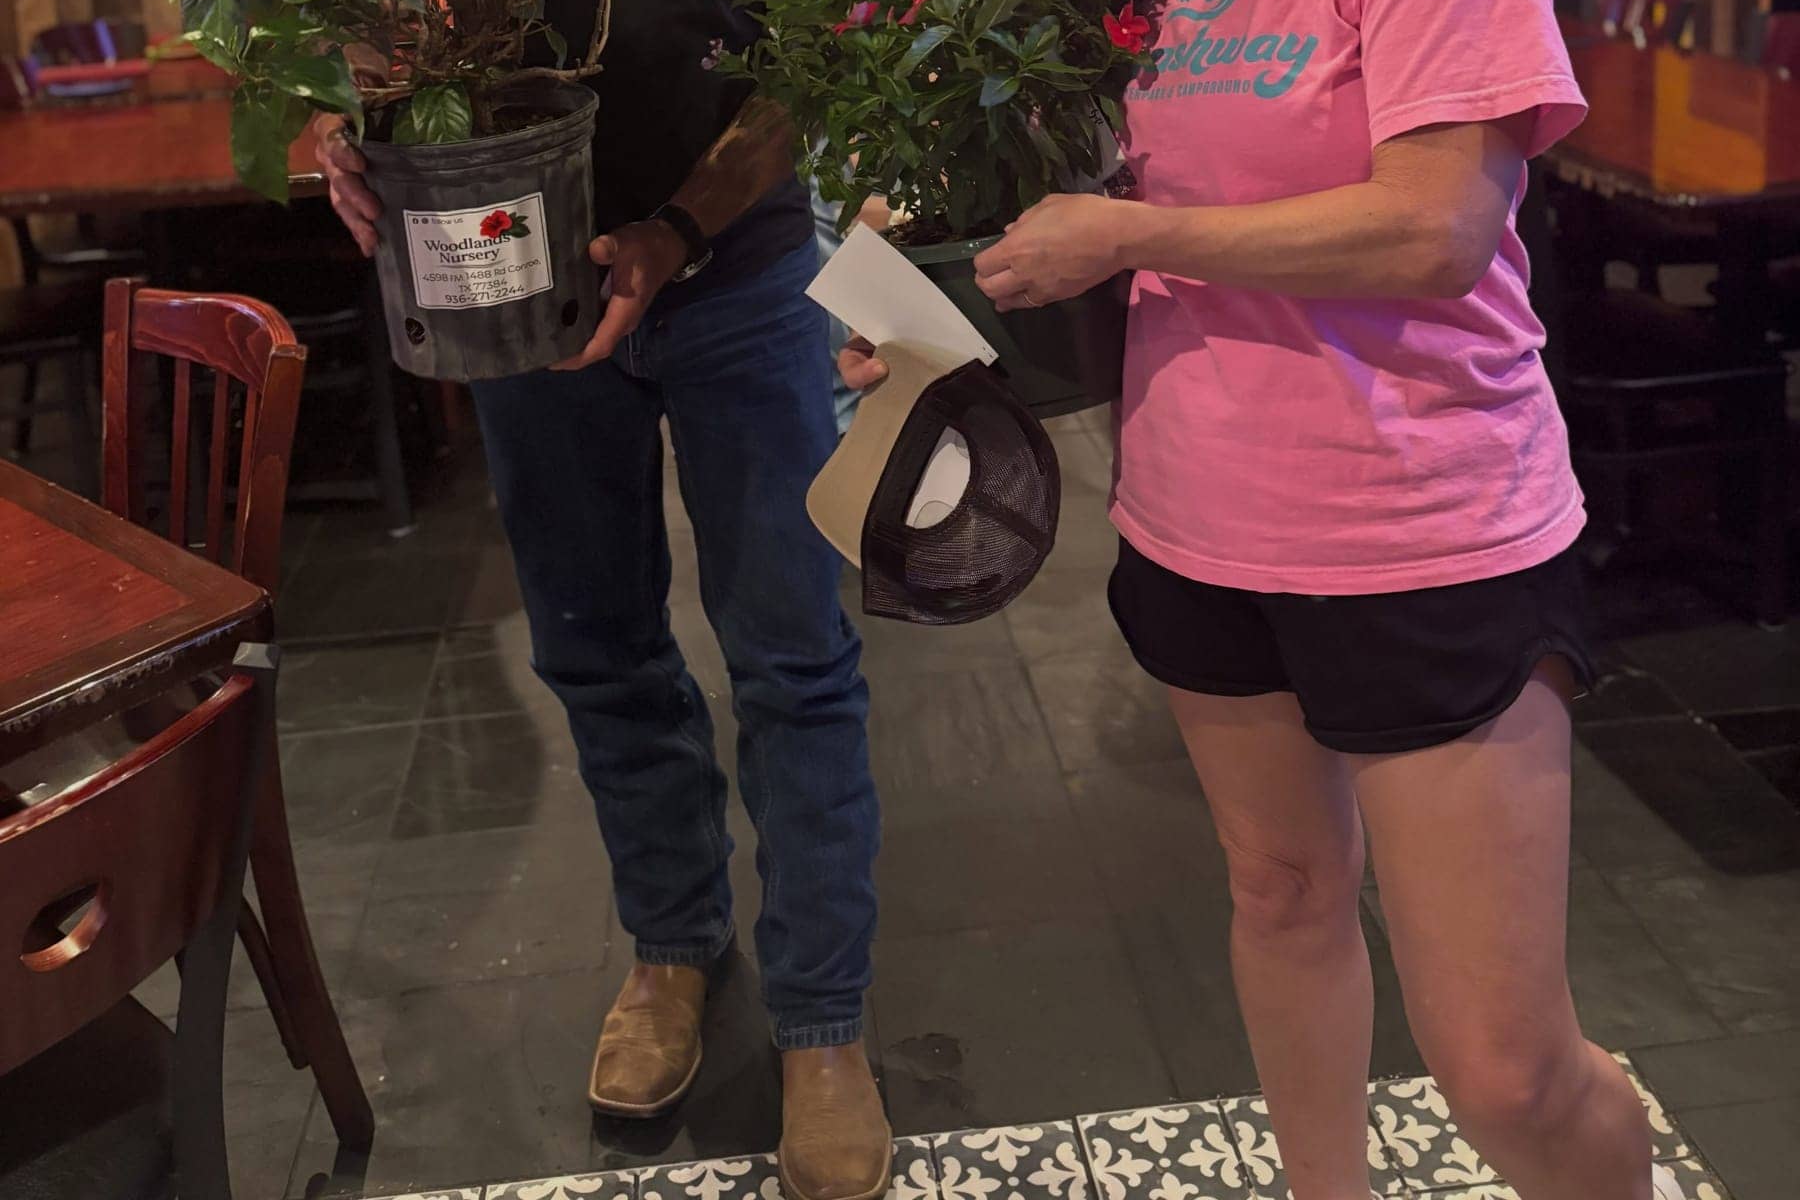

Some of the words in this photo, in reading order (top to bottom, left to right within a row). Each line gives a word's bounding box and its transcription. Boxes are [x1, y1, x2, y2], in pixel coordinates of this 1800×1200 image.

[1177, 80, 1251, 97] CAMPGROUND
[423, 233, 511, 252] Woodlands
[439, 247, 500, 264] Nursery
[422, 273, 448, 283] 4598
[494, 266, 506, 277] Rd
[445, 285, 525, 304] 936-271-2244
[459, 284, 472, 293] TX
[473, 279, 508, 292] 77384
